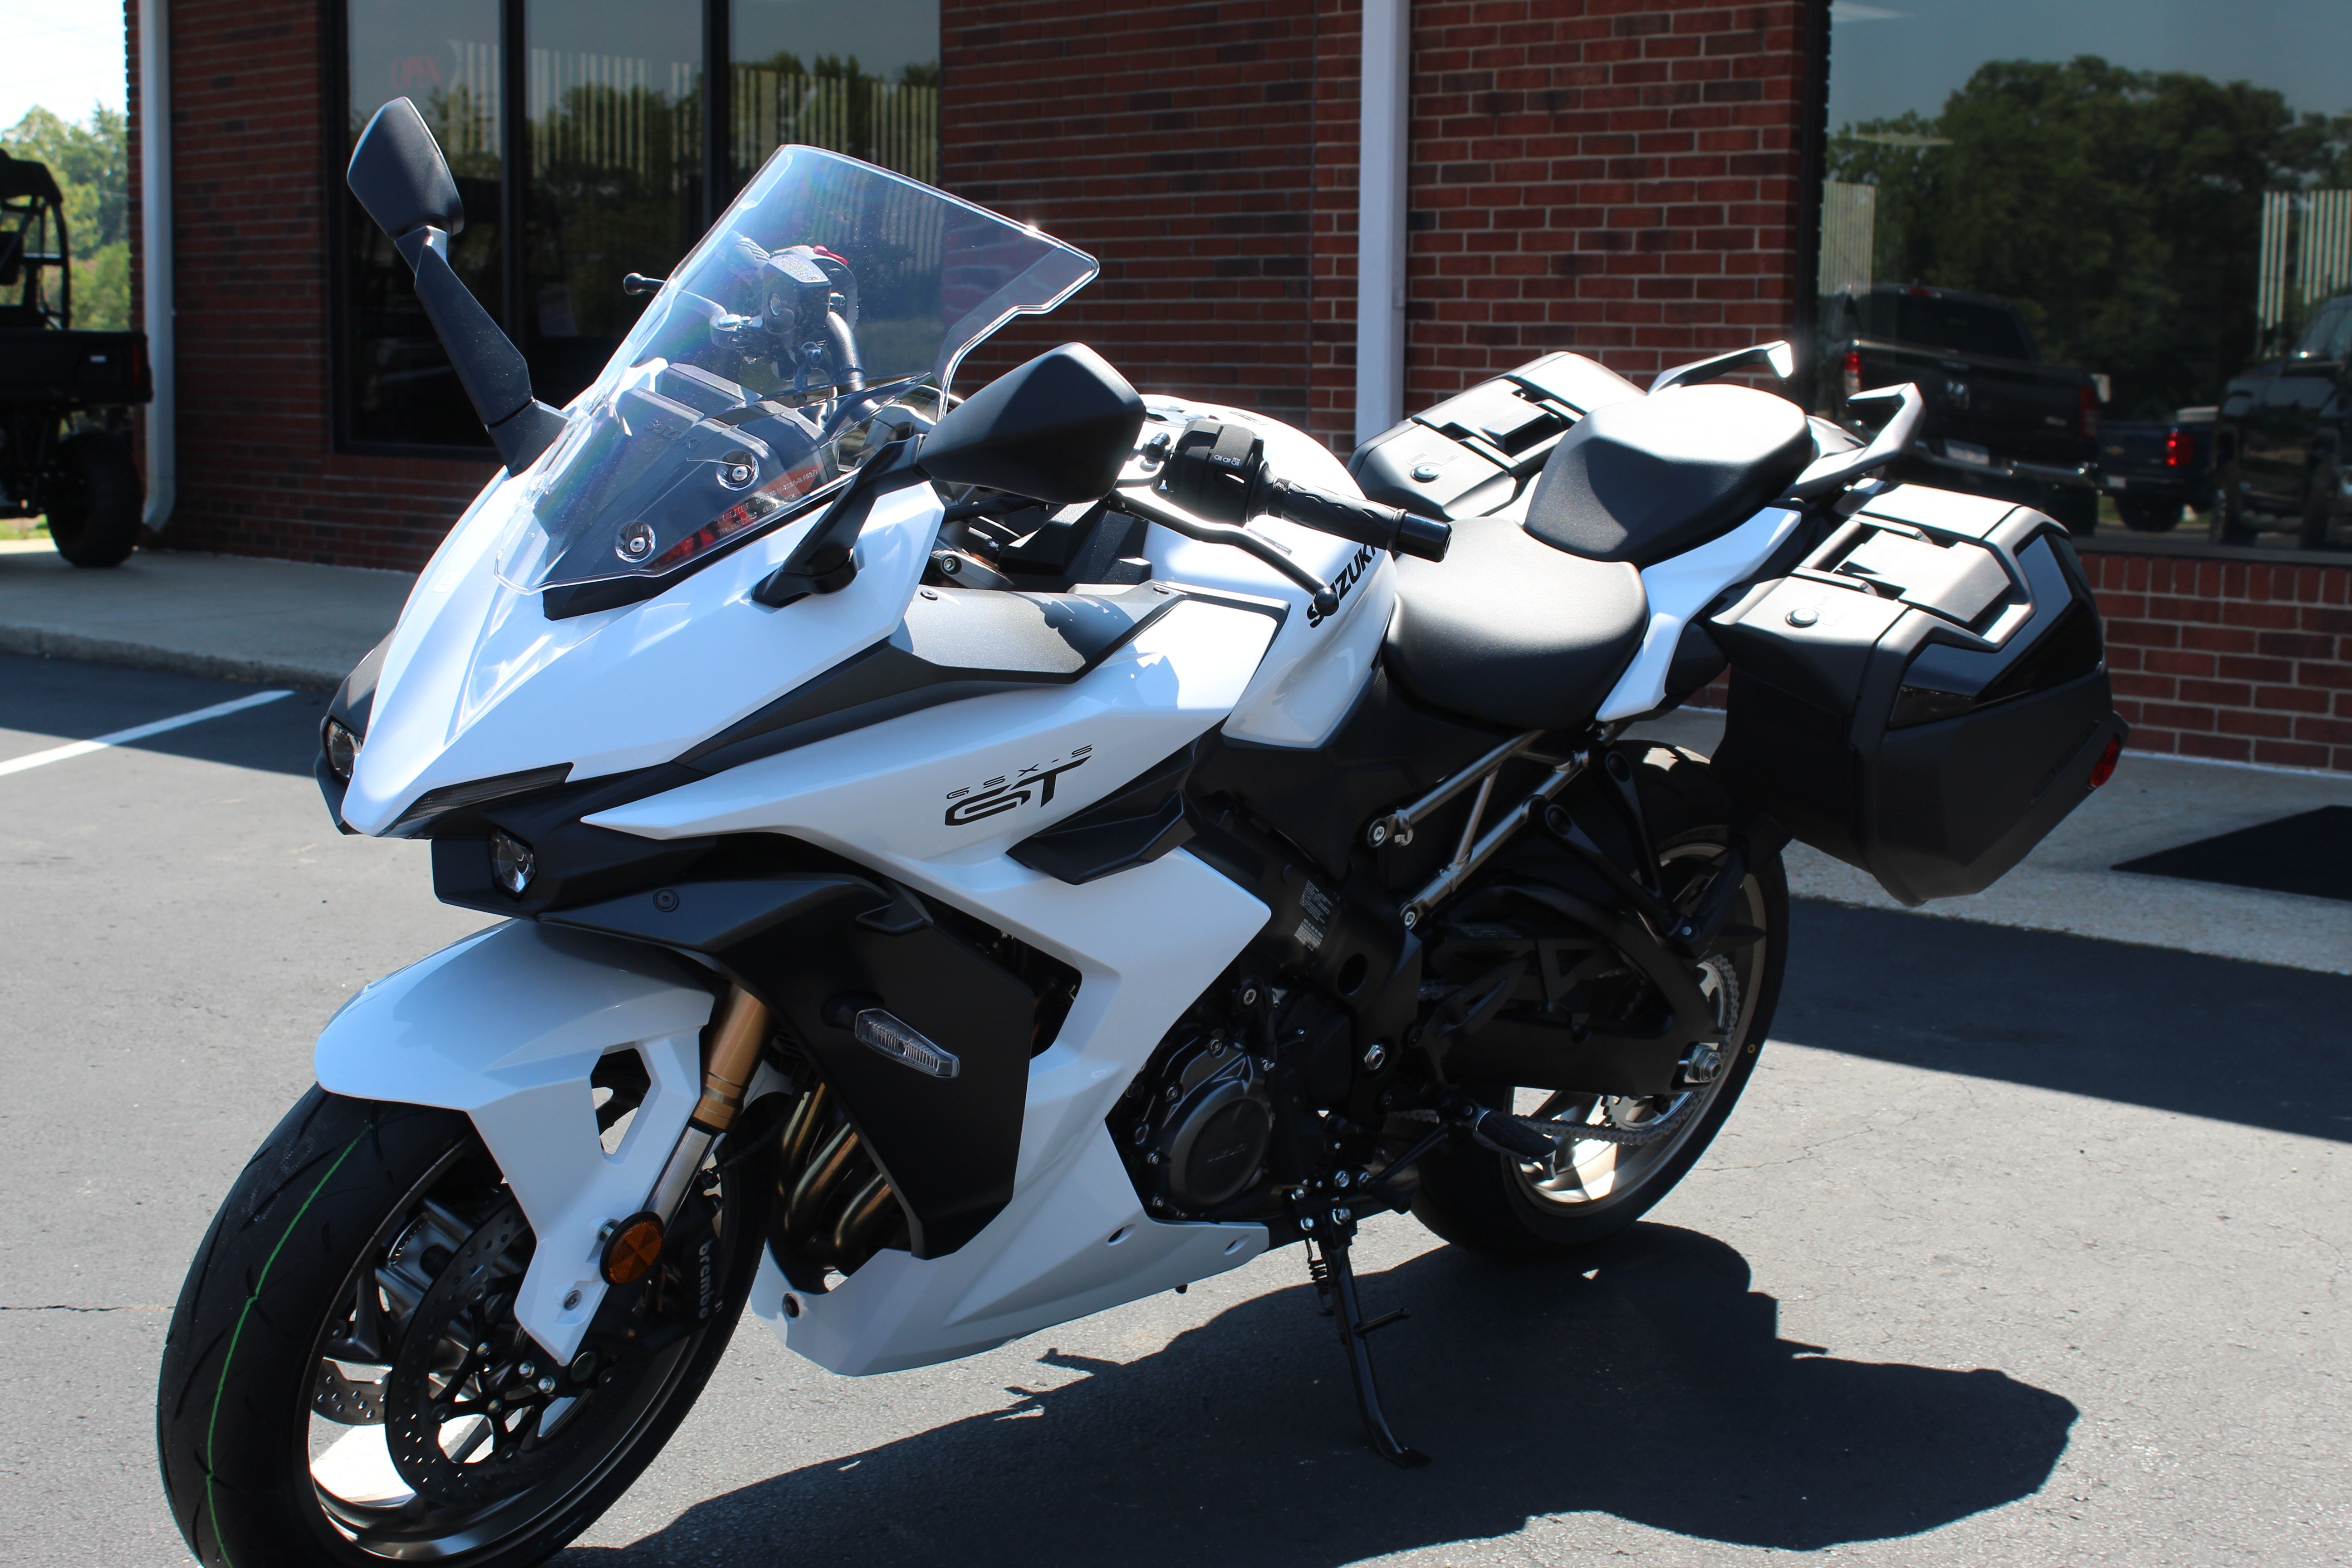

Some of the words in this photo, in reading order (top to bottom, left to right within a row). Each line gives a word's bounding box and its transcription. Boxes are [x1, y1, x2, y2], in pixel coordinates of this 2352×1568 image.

[391, 56, 440, 90] OPEN
[645, 418, 702, 451] SUZUKI
[1307, 544, 1376, 628] SZUK
[945, 755, 1092, 826] GT
[946, 744, 1093, 799] GSX-S
[699, 1239, 715, 1319] brembo
